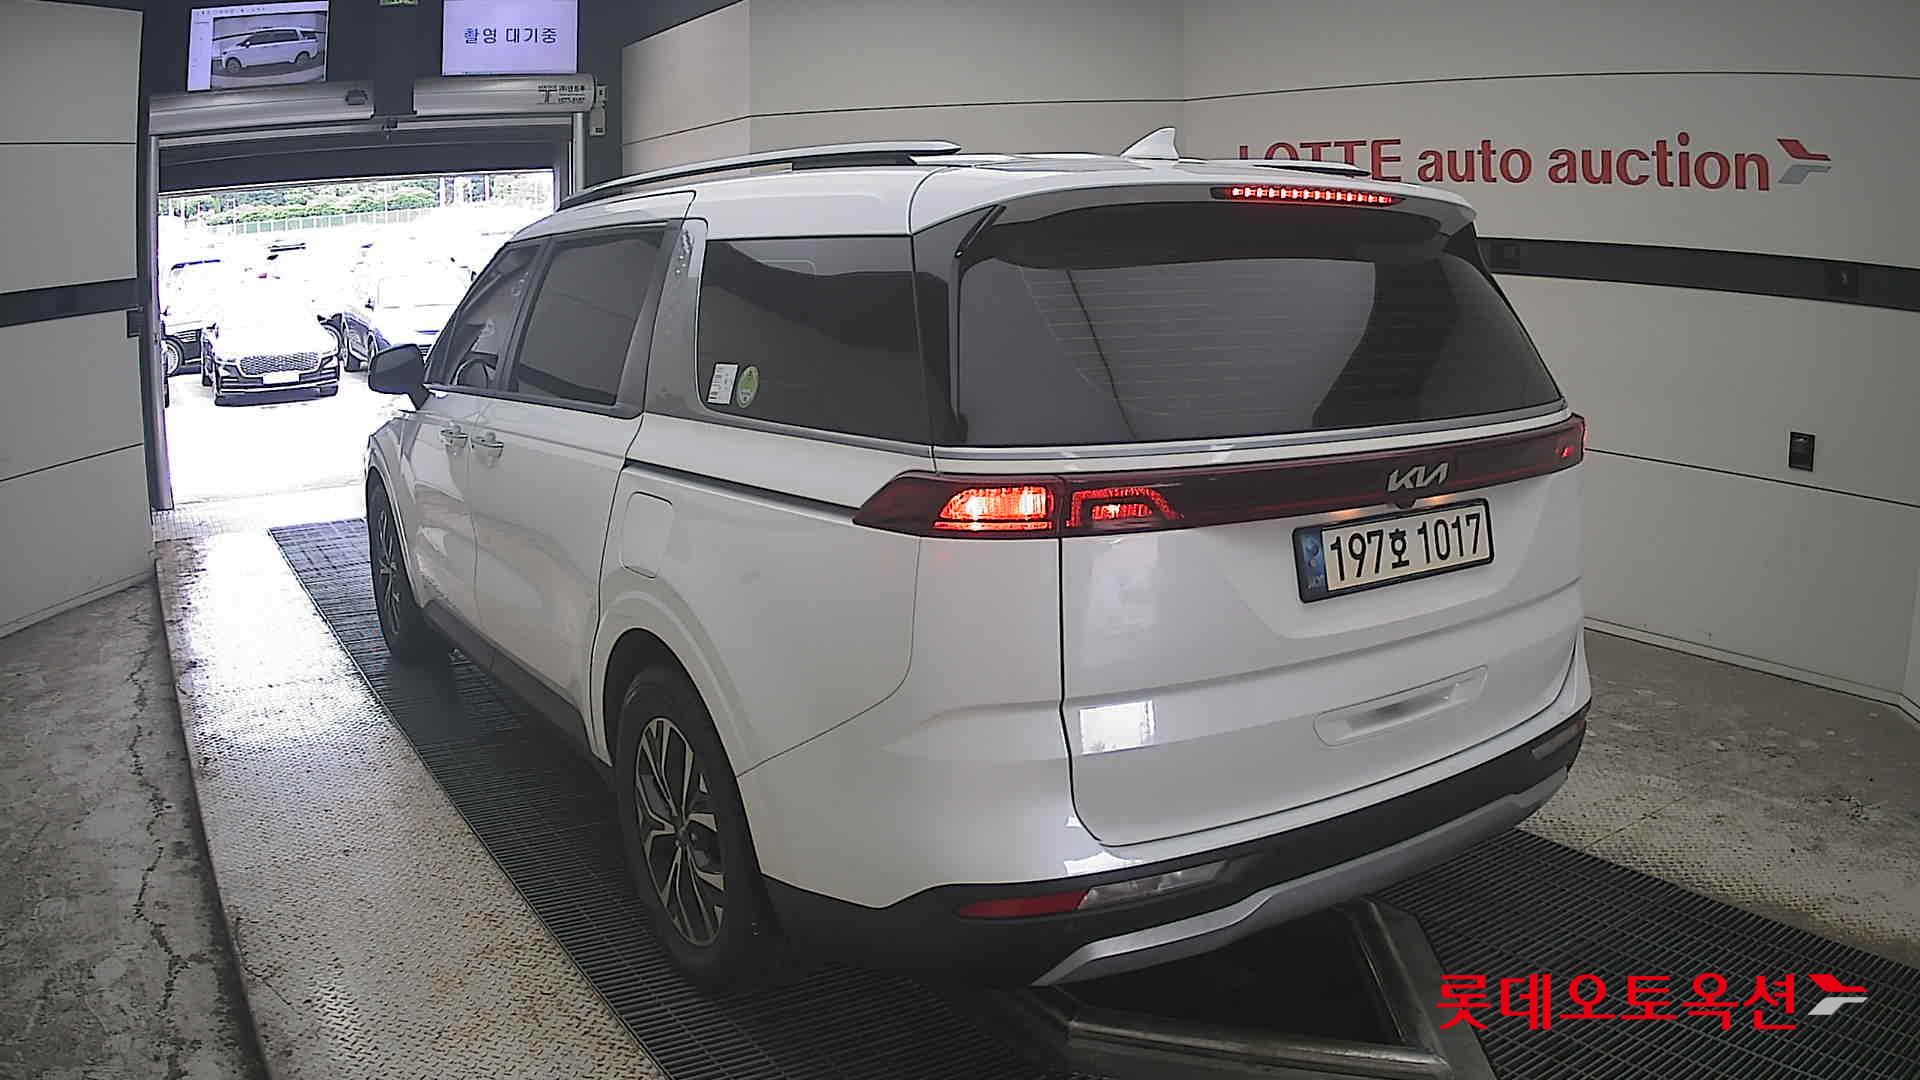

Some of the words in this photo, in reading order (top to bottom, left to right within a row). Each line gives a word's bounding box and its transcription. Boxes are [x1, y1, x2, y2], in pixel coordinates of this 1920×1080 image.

[464, 27, 497, 45] 촬영
[505, 27, 558, 44] 대기중
[1417, 139, 1532, 184] auto
[1548, 131, 1770, 191] auction
[1386, 462, 1449, 492] KIA
[1330, 528, 1410, 582] 197호
[1417, 513, 1481, 564] 1017
